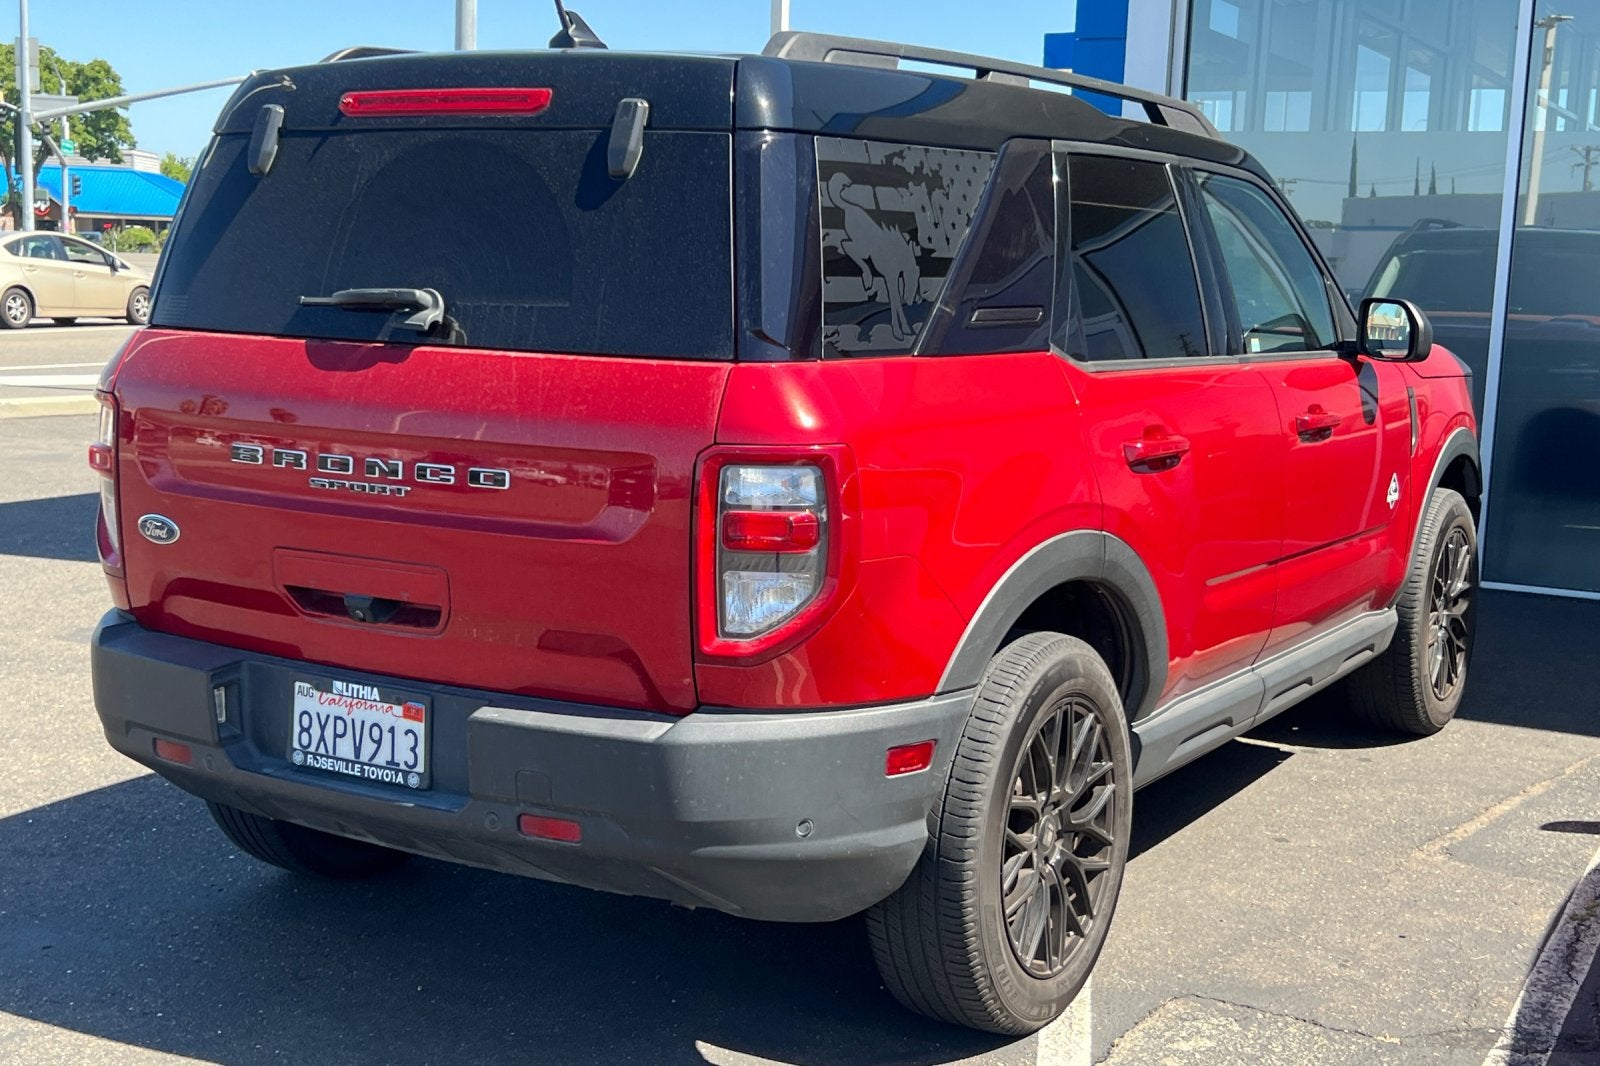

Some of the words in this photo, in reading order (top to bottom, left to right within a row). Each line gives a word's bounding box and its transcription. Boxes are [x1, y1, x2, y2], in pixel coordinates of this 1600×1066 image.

[230, 442, 511, 490] BRONCO
[308, 477, 411, 497] SPORT
[145, 519, 168, 538] Ford
[296, 684, 315, 699] AUG
[318, 690, 404, 716] California
[343, 682, 380, 701] LITHIA
[298, 709, 419, 770] 8XPV913
[306, 754, 361, 776] ROSEVILLE
[363, 765, 404, 785] TOYOTA
